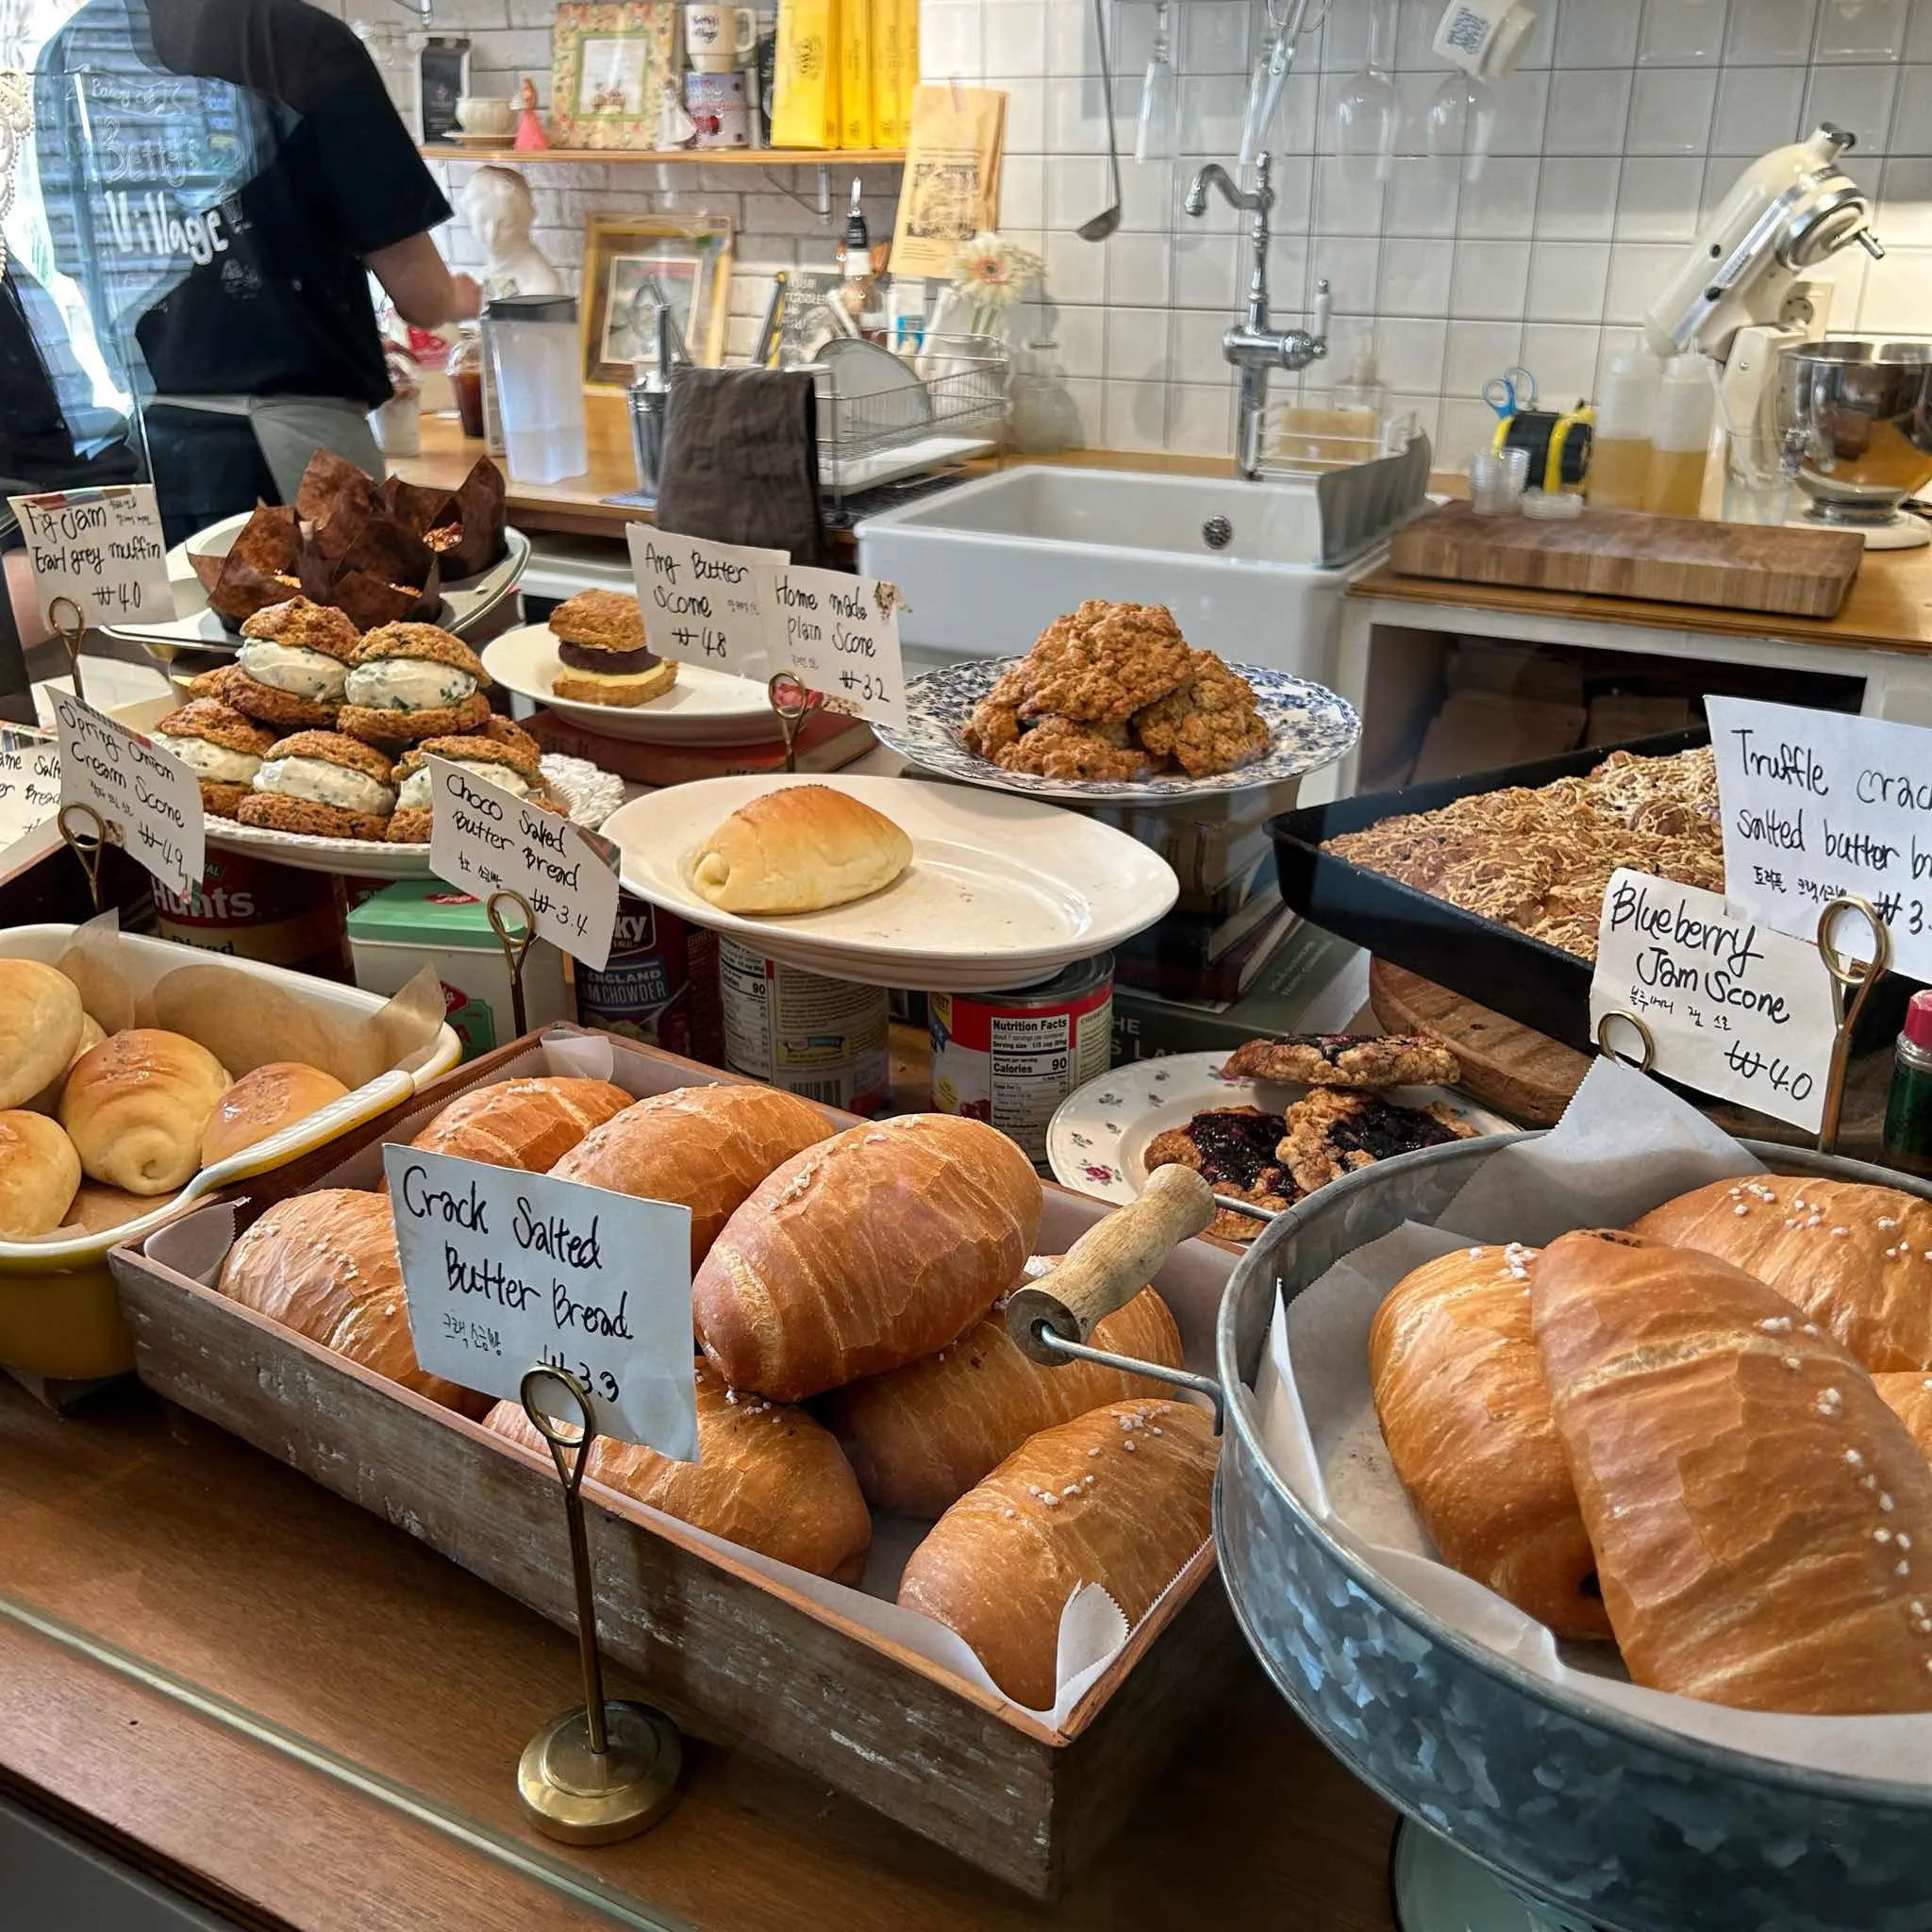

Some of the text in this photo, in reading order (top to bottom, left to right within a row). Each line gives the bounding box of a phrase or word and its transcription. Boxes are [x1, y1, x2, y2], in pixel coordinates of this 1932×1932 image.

[104, 190, 229, 265] Village
[60, 506, 107, 541] jam
[31, 535, 160, 575] Earl grey muffin
[691, 549, 749, 585] Butter
[653, 585, 712, 619] Scone
[774, 574, 819, 611] Home
[831, 622, 877, 658] Scone
[71, 741, 127, 790] Cream
[134, 774, 185, 828] Scone
[127, 741, 175, 784] Onion
[1730, 728, 1932, 810] Truffle crac
[446, 774, 504, 822] Choco
[452, 810, 581, 891] Butter Bread
[1824, 820, 1901, 871] butter
[1610, 880, 1764, 977] Blueberry
[1636, 946, 1790, 1024] Jam Scone
[993, 1019, 1067, 1032] Nutrition Facts
[993, 1062, 1033, 1074] Calories
[1052, 1057, 1067, 1071] 90
[403, 1165, 603, 1270] Crack Salted
[444, 1240, 633, 1341] Butter Bread
